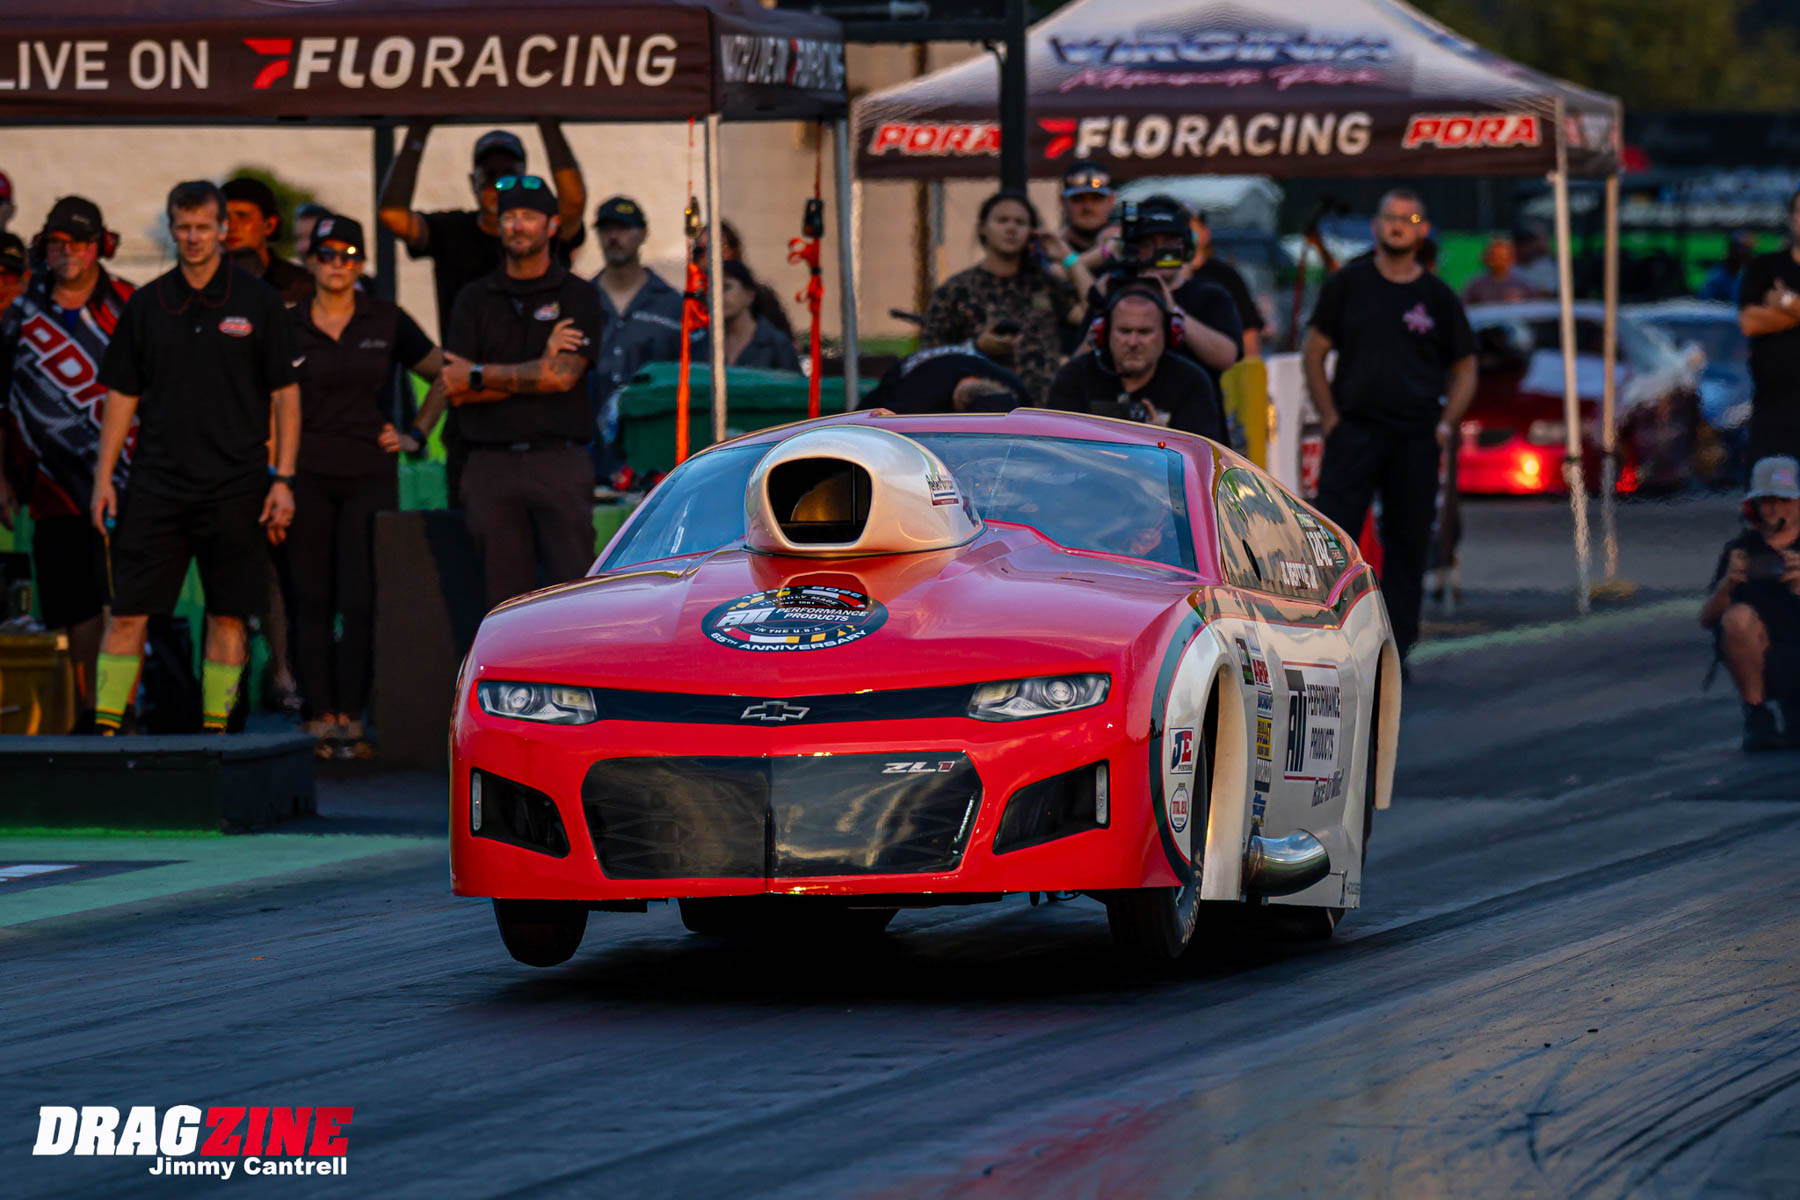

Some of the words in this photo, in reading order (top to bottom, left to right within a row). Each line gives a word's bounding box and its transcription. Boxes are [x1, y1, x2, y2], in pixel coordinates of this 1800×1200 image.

[129, 40, 208, 89] ON
[293, 34, 677, 89] FLORACING
[1074, 111, 1373, 158] FLORACING
[1402, 113, 1541, 148] PDRA
[716, 607, 776, 627] ATI
[776, 607, 868, 617] PERFORMANCE
[784, 612, 849, 622] PRODUCTS
[738, 630, 867, 651] ANNIVERSARY
[1306, 684, 1341, 719] PERFORMANCE
[1171, 730, 1192, 769] JE
[1309, 727, 1334, 761] PRODUCTS
[881, 761, 955, 773] ZL1
